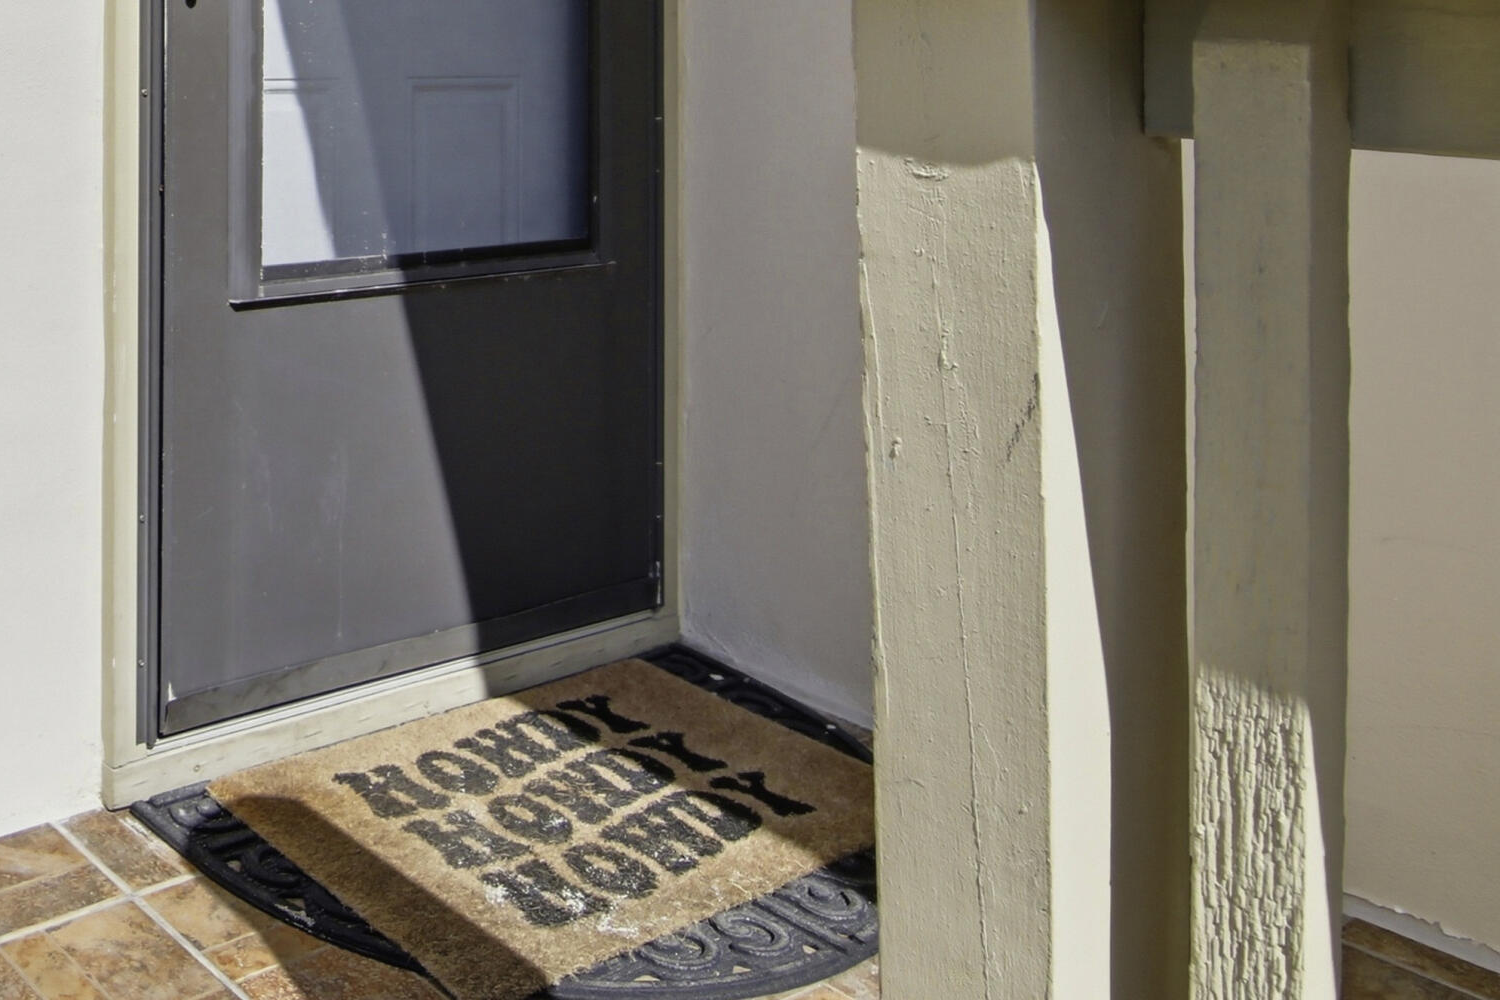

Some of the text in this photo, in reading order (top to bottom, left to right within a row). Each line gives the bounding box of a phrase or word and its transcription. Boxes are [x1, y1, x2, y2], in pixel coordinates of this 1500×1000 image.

[333, 693, 651, 819] HOWDY
[401, 730, 728, 870] HOWDY
[478, 769, 817, 927] HOWDY
